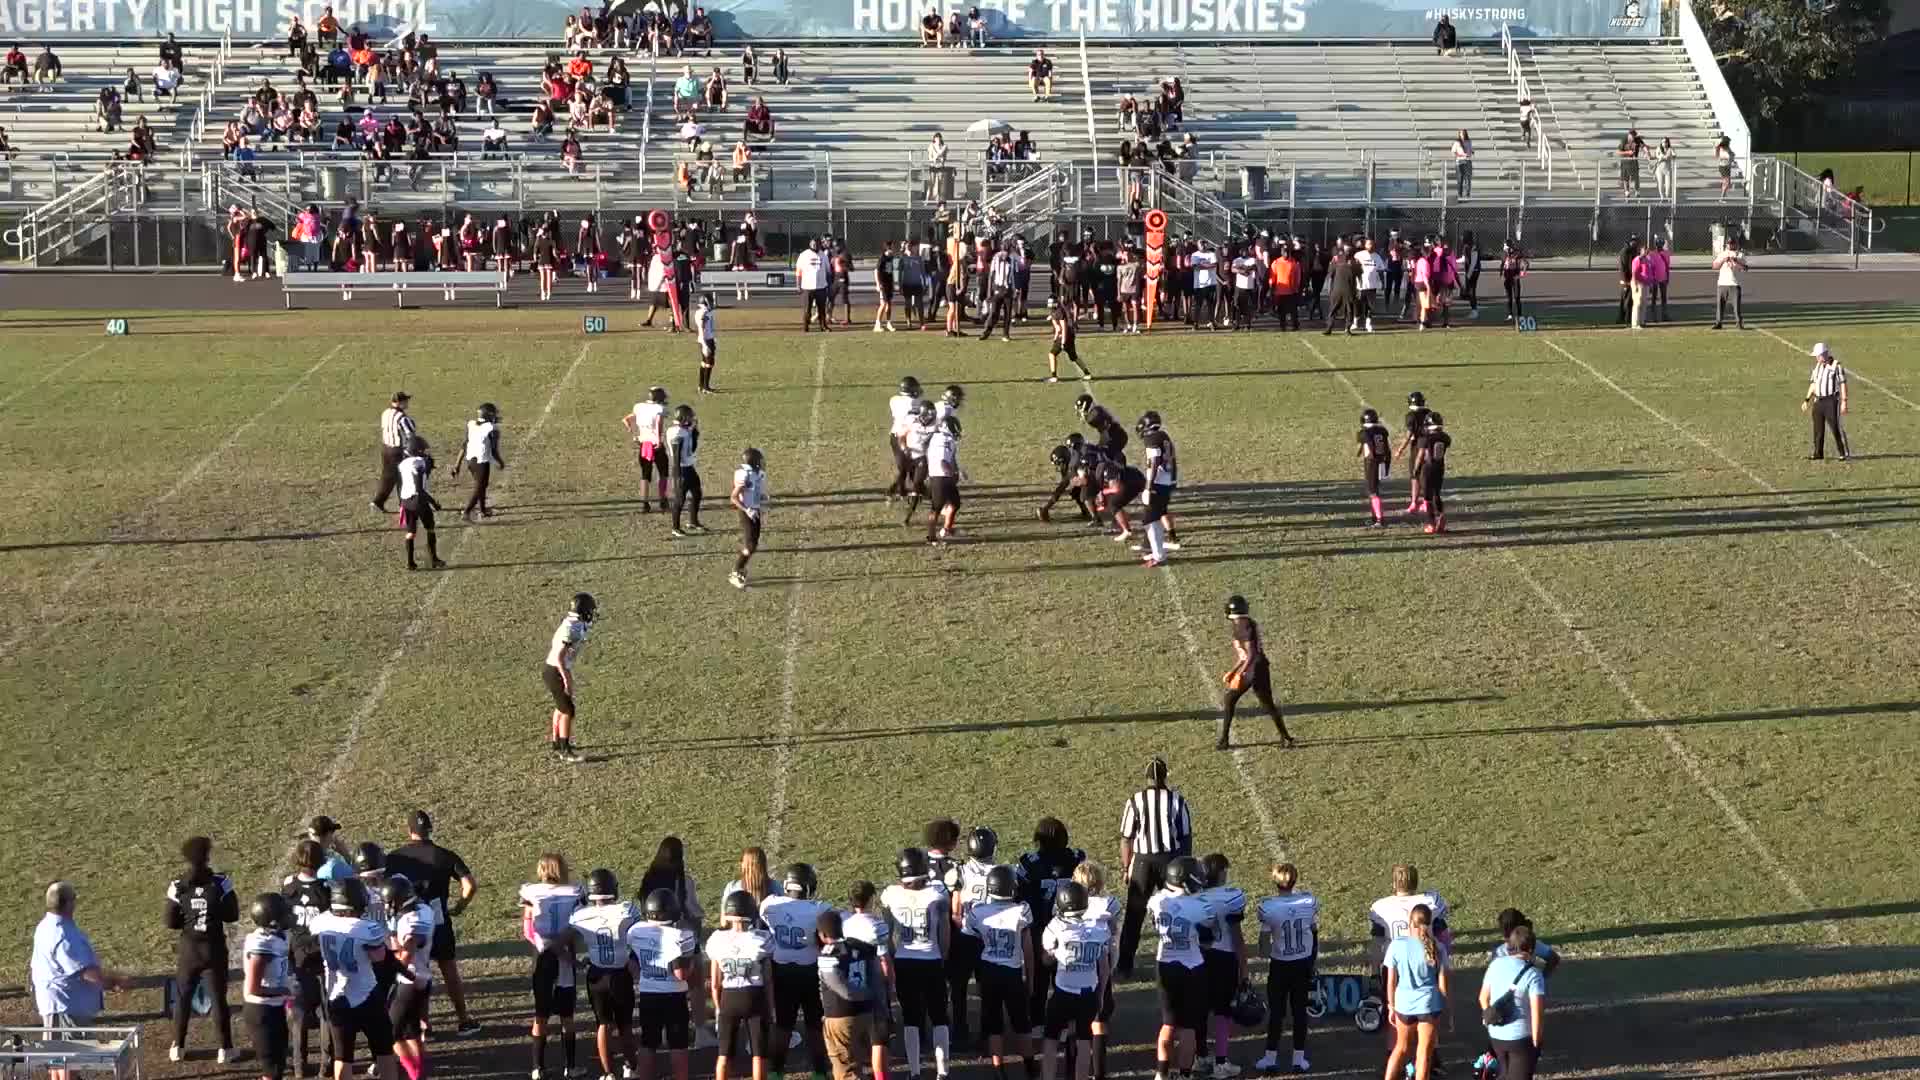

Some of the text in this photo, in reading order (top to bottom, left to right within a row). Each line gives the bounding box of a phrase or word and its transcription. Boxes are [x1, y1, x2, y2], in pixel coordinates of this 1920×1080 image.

[164, 0, 261, 32] HIGH
[853, 0, 962, 31] HOME
[1047, 0, 1121, 32] THE
[1134, 0, 1305, 32] HUSKIES
[1425, 8, 1526, 20] #HUSKYSTRONG
[107, 319, 125, 334] 40
[586, 317, 603, 332] 50
[1519, 316, 1536, 330] 30
[1281, 918, 1306, 956] 11
